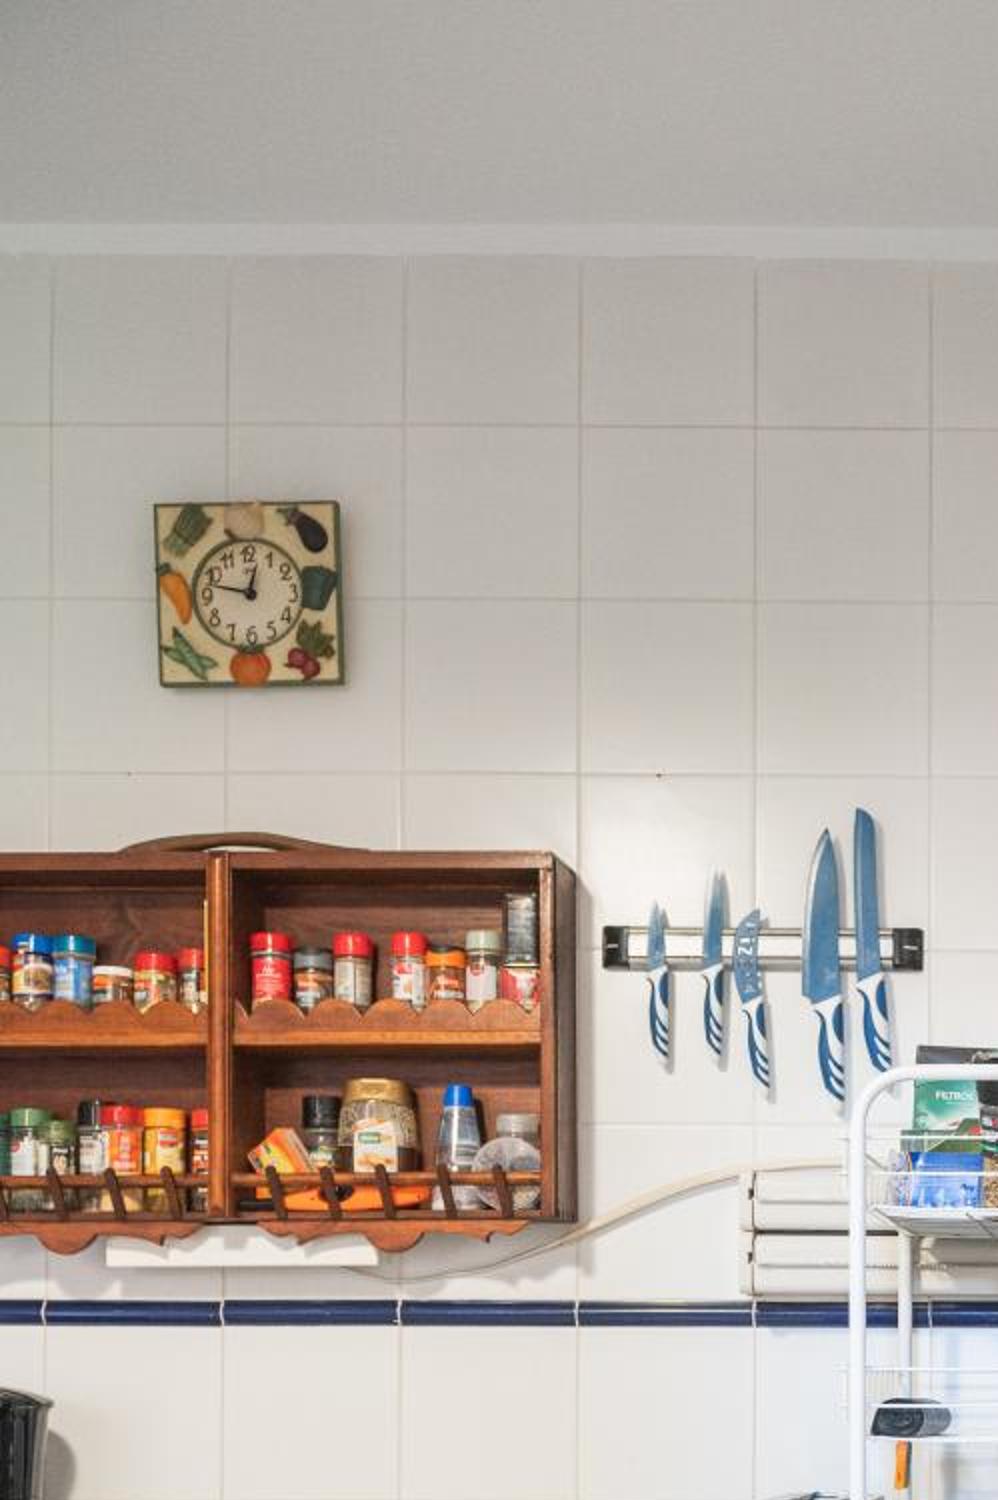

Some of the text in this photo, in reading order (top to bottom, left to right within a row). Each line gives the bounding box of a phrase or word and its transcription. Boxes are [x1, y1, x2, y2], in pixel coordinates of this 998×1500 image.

[220, 550, 235, 569] 11
[240, 544, 256, 563] 12
[265, 552, 274, 569] 1
[206, 566, 223, 587] 10
[279, 563, 293, 581] 2
[201, 586, 213, 607] 9
[288, 583, 299, 603] 3
[209, 607, 221, 627] 8
[281, 606, 292, 625] 4
[226, 623, 236, 641] 7
[246, 625, 258, 646] 6
[266, 620, 277, 641] 5
